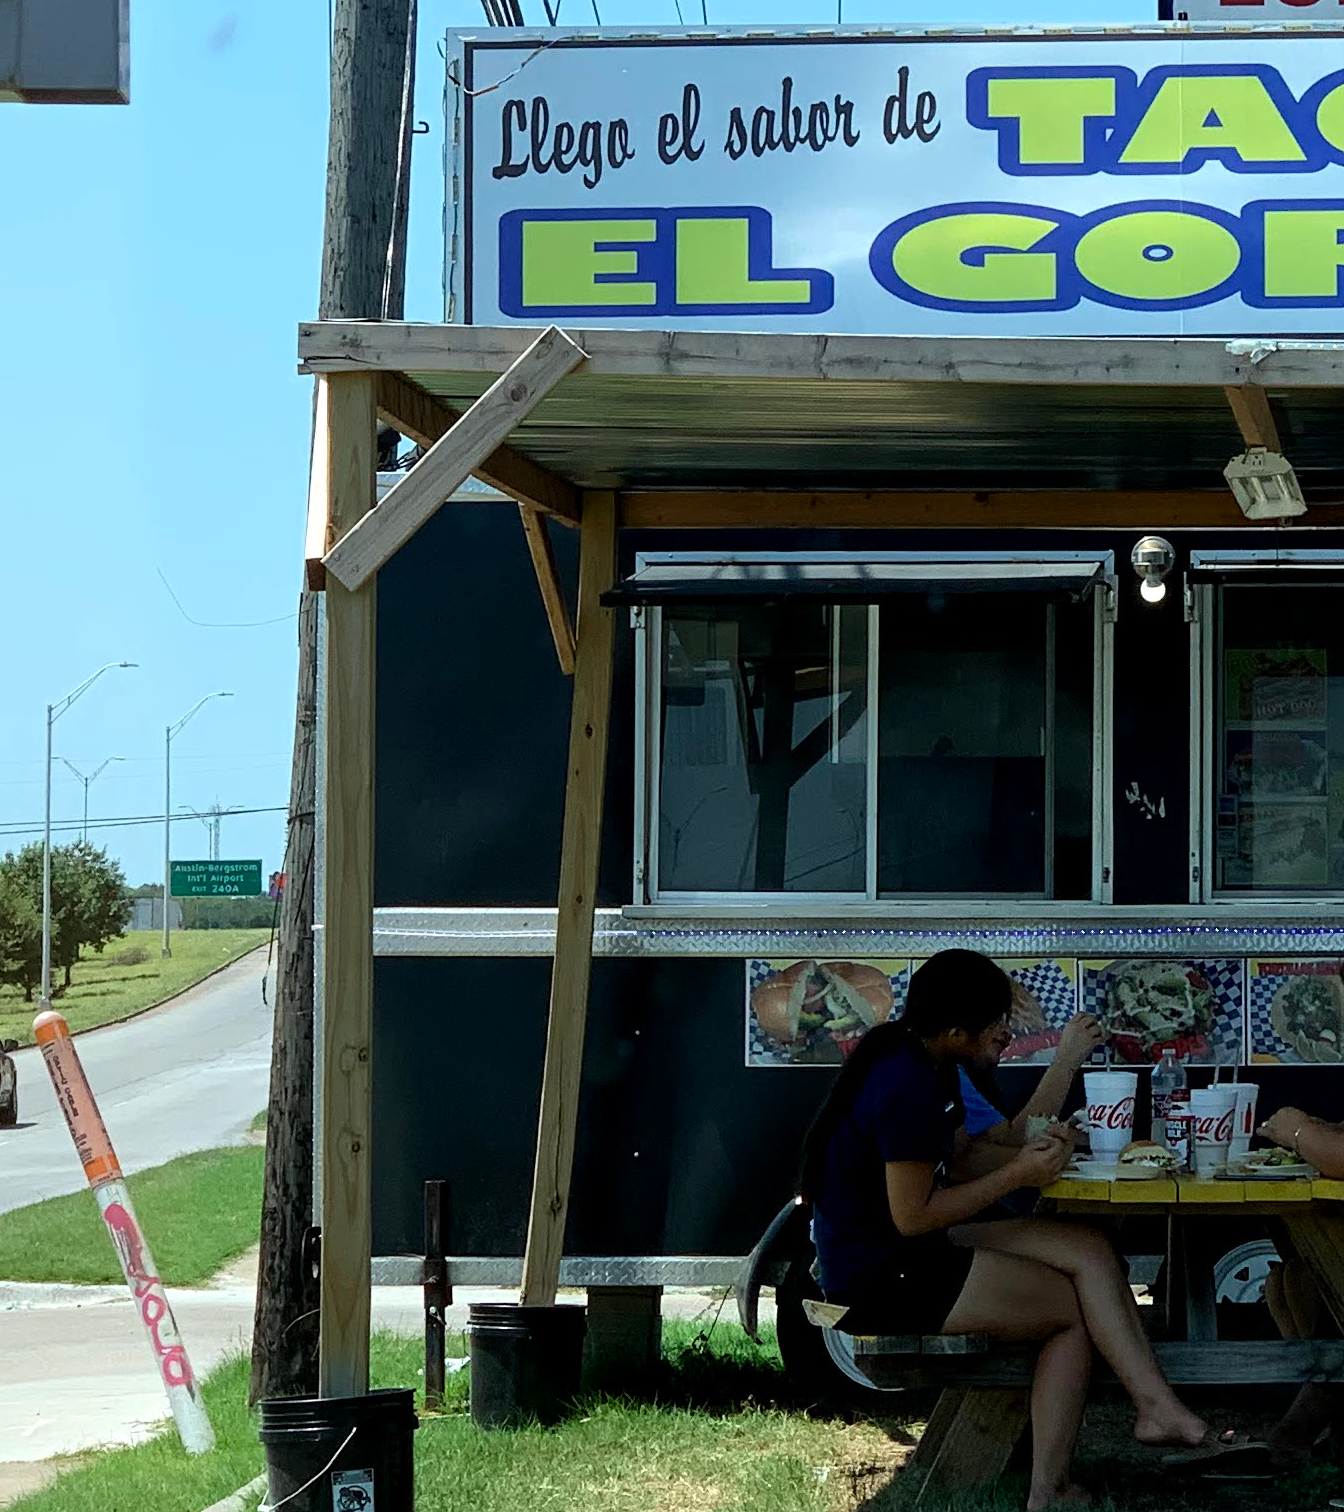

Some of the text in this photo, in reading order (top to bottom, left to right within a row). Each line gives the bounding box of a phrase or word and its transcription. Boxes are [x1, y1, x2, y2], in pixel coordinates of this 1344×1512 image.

[492, 66, 941, 189] Llego el sabor de
[500, 206, 834, 318] EL
[175, 864, 257, 873] Austin-Bergstrom
[187, 874, 243, 883] Int'l Airport
[212, 885, 239, 893] 240A
